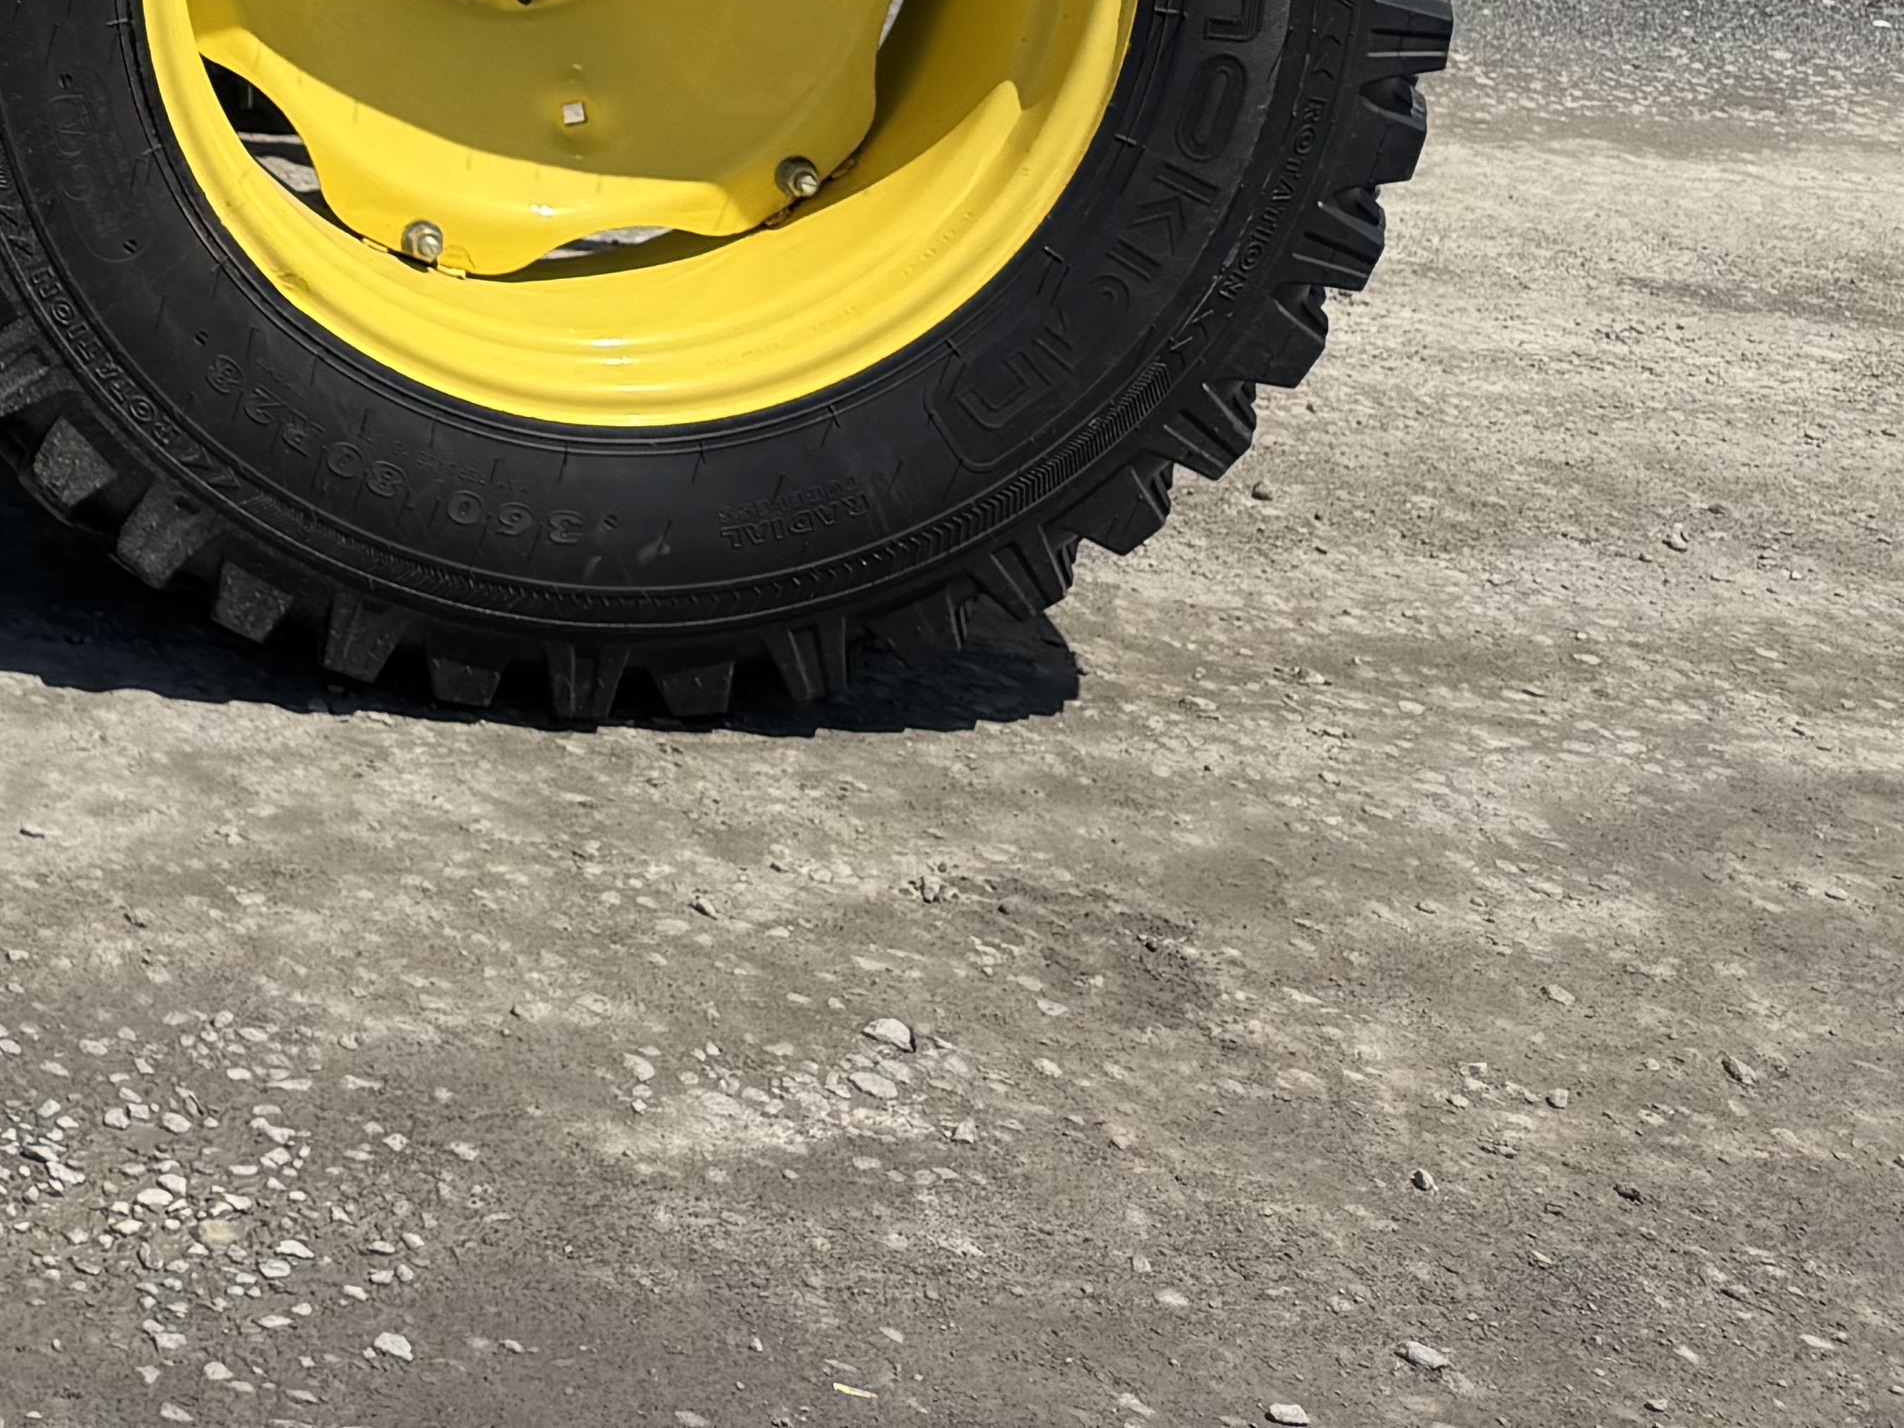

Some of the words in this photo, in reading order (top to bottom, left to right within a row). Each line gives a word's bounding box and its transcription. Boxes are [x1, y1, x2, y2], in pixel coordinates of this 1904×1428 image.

[1216, 96, 1326, 304] ROTATION
[34, 266, 182, 447] ROTATION
[718, 490, 873, 550] RADIAL
